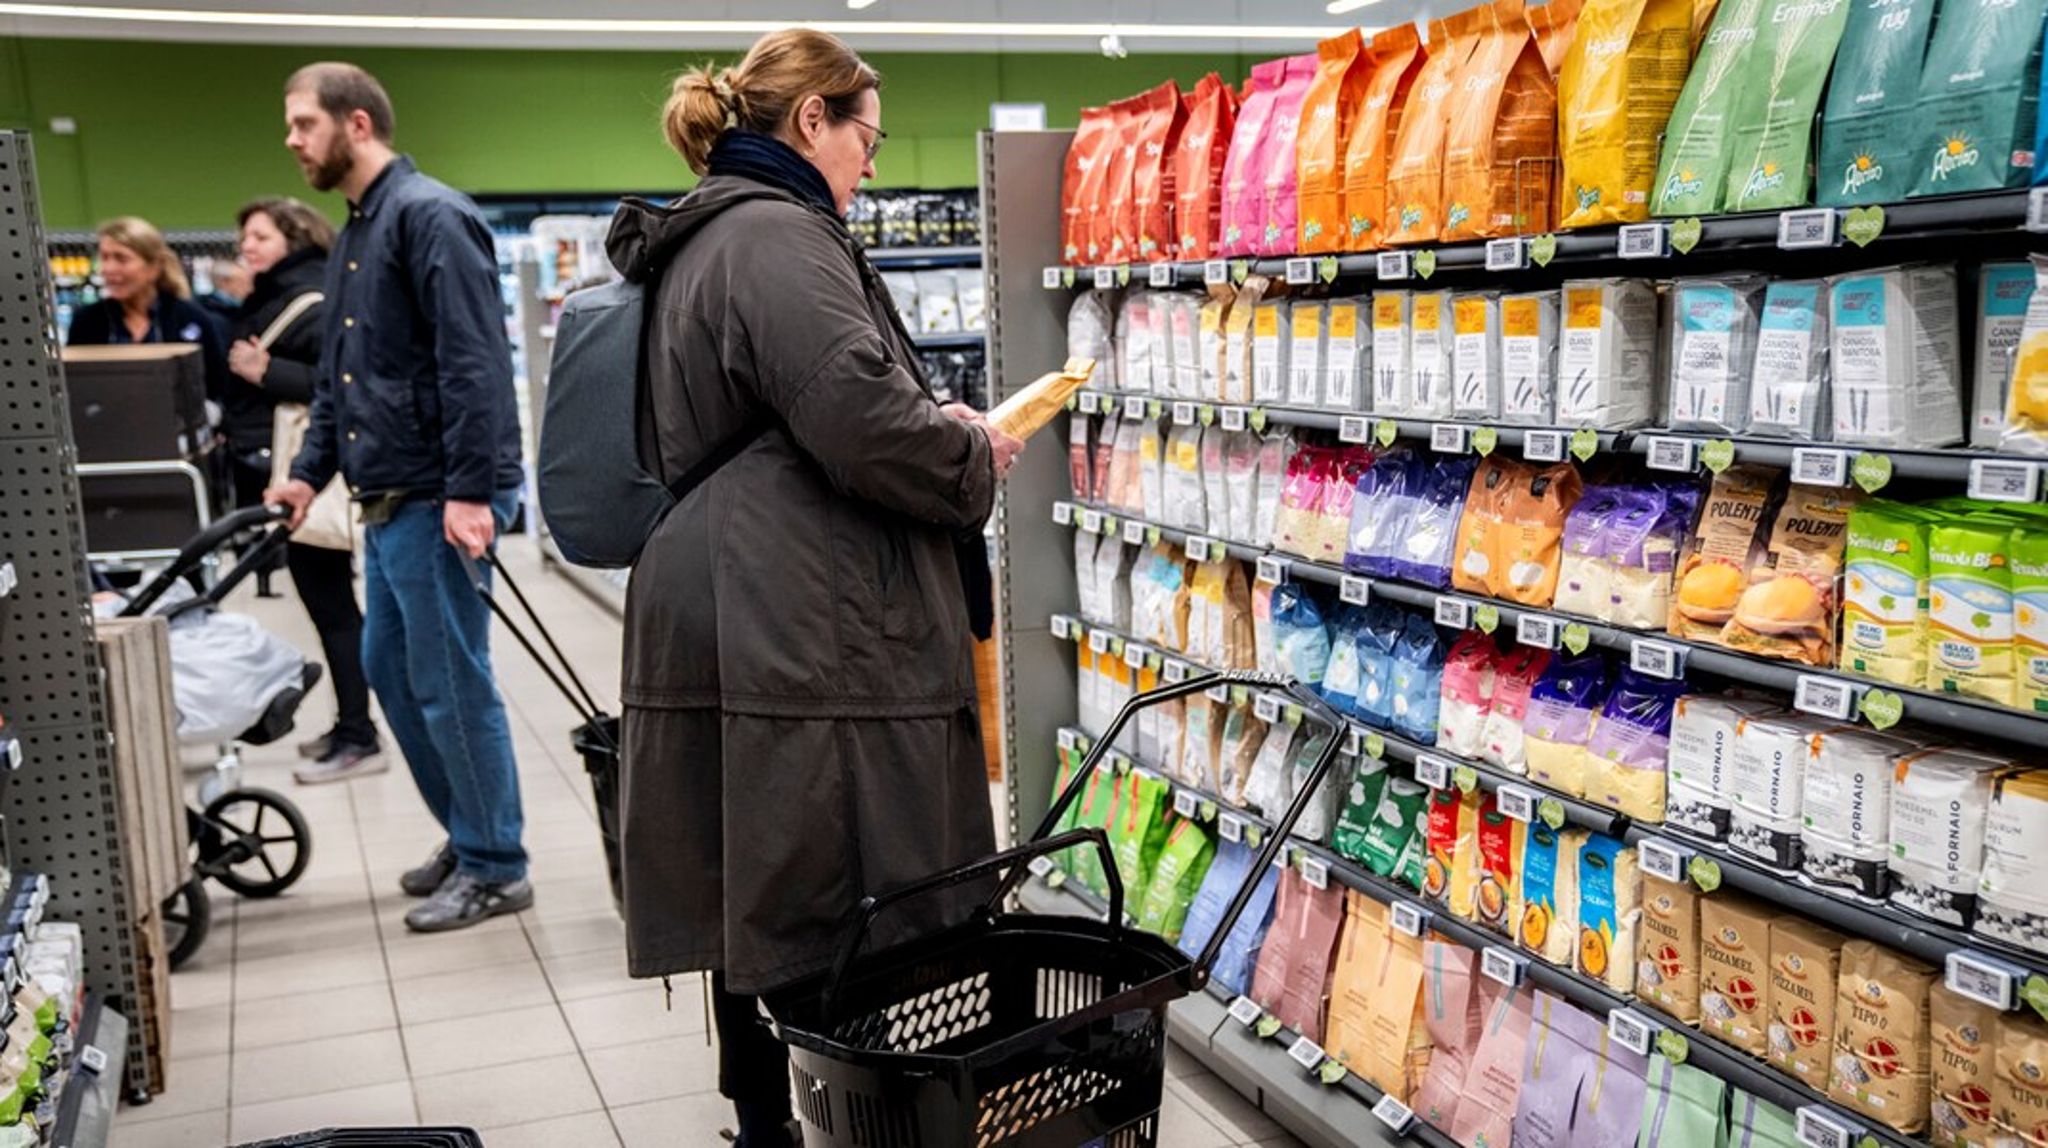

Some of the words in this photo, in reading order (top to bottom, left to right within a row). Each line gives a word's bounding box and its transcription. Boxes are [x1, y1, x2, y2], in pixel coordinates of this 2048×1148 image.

[1852, 772, 1865, 840] FORNAIO
[1947, 800, 1961, 872] FORNAIO
[1702, 943, 1755, 974] PIZZAMEL
[1852, 1004, 1878, 1026] TIPO
